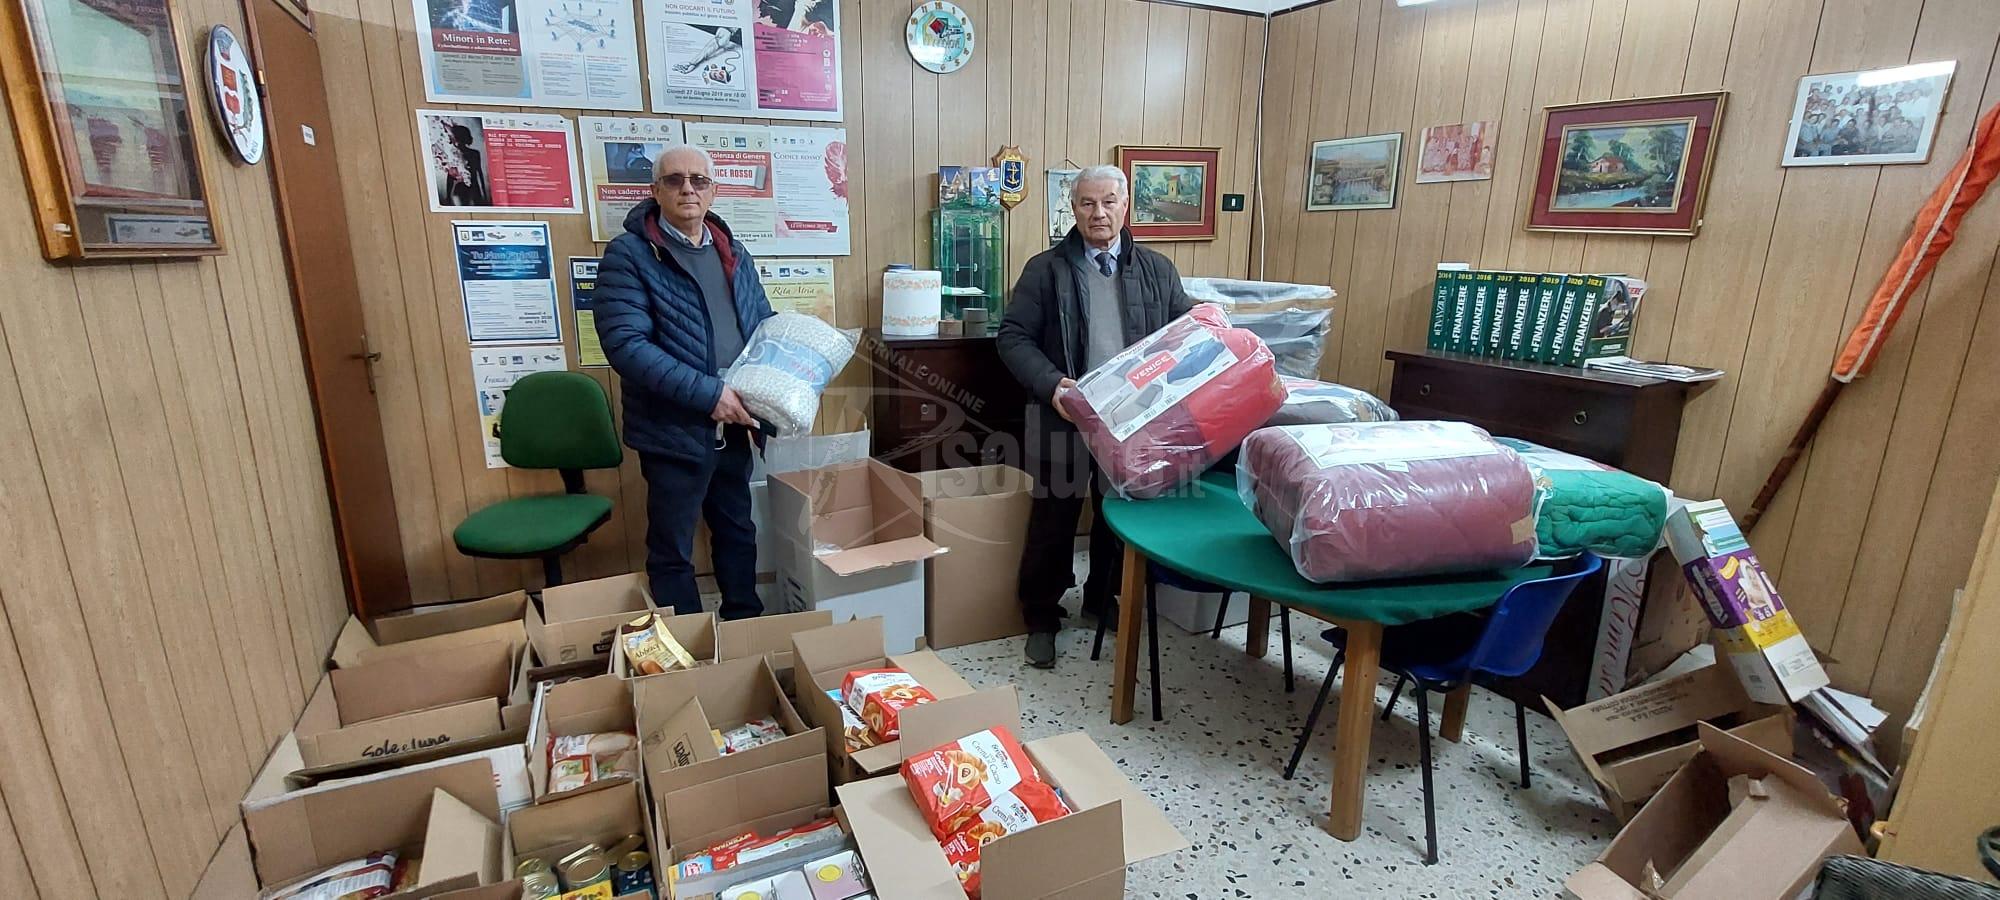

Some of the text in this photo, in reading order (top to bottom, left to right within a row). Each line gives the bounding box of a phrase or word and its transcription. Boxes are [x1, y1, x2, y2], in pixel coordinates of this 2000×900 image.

[442, 32, 474, 43] Minori
[476, 35, 485, 44] in
[729, 169, 753, 179] ROSSO
[601, 187, 617, 195] Non
[772, 286, 791, 296] Rita
[1541, 276, 1560, 284] 2019
[1567, 277, 1584, 286] 2020
[1587, 278, 1603, 287] 2021
[1451, 284, 1468, 339] FINANZIERE
[1470, 285, 1487, 341] FINANZIERE
[1489, 286, 1508, 343] FINANZIERE
[1510, 288, 1530, 346] FINANZIERE
[1531, 289, 1553, 348] FINANZIERE
[1552, 290, 1576, 351] FINANZIERE
[1572, 292, 1596, 354] FINANZIERE
[1131, 354, 1173, 380] VENICE
[362, 738, 400, 757] Sole
[411, 733, 450, 751] luna
[971, 740, 990, 760] Crema
[989, 764, 1001, 785] Cacao
[991, 805, 1009, 823] Crema
